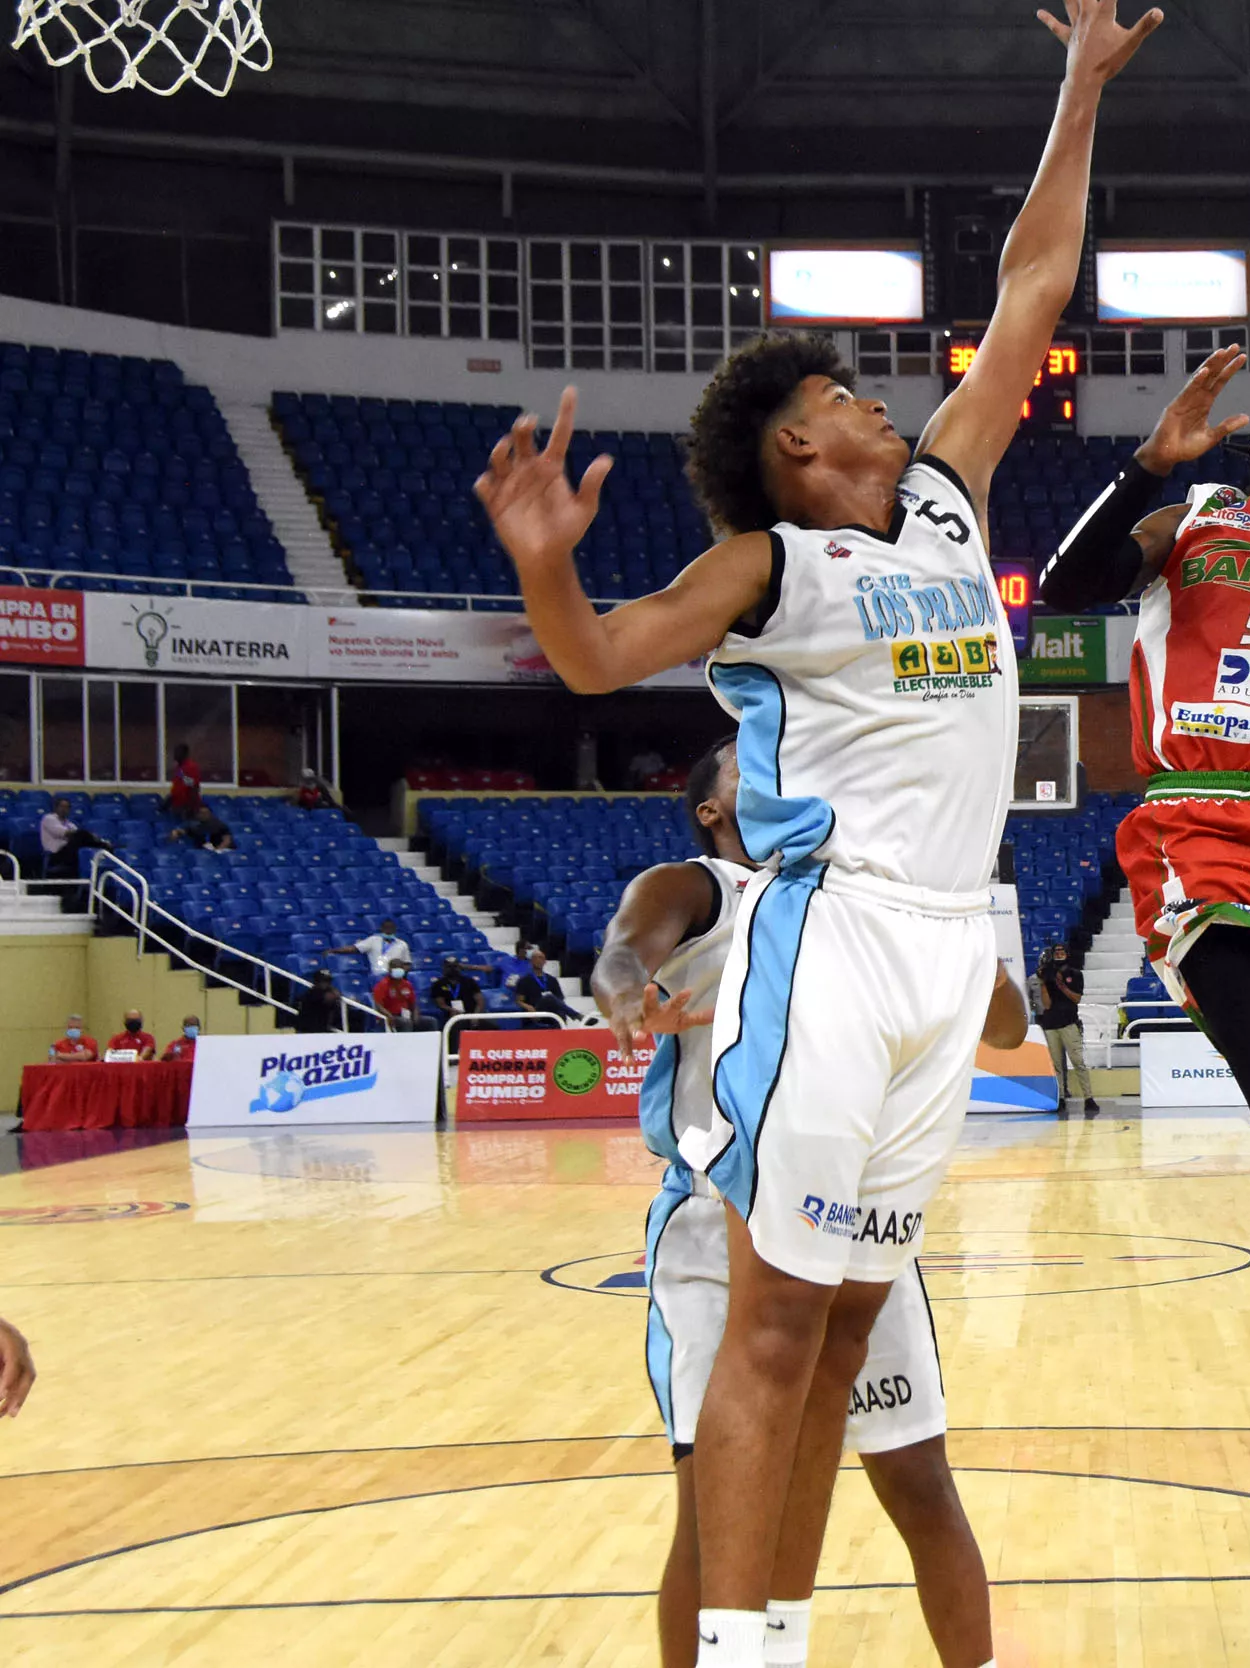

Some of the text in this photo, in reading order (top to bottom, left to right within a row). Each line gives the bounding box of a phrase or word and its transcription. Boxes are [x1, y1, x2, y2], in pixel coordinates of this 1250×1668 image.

[1049, 349, 1076, 374] 37
[1064, 400, 1072, 419] 1
[914, 499, 971, 546] 5
[855, 573, 912, 594] CUB
[1001, 576, 1025, 605] 10
[50, 602, 77, 619] EN
[853, 573, 998, 641] LOS PRADO
[172, 637, 289, 660] INKATERRA
[894, 675, 993, 693] ELECTROMUEBLES
[260, 1043, 364, 1078] Planeta
[470, 1049, 548, 1060] EL QUE SABE
[302, 1050, 372, 1087] azul
[469, 1061, 546, 1072] AHORRAR
[467, 1074, 545, 1085] COMPRA EN
[465, 1086, 546, 1099] JUMBO
[848, 1375, 912, 1415] AASD
